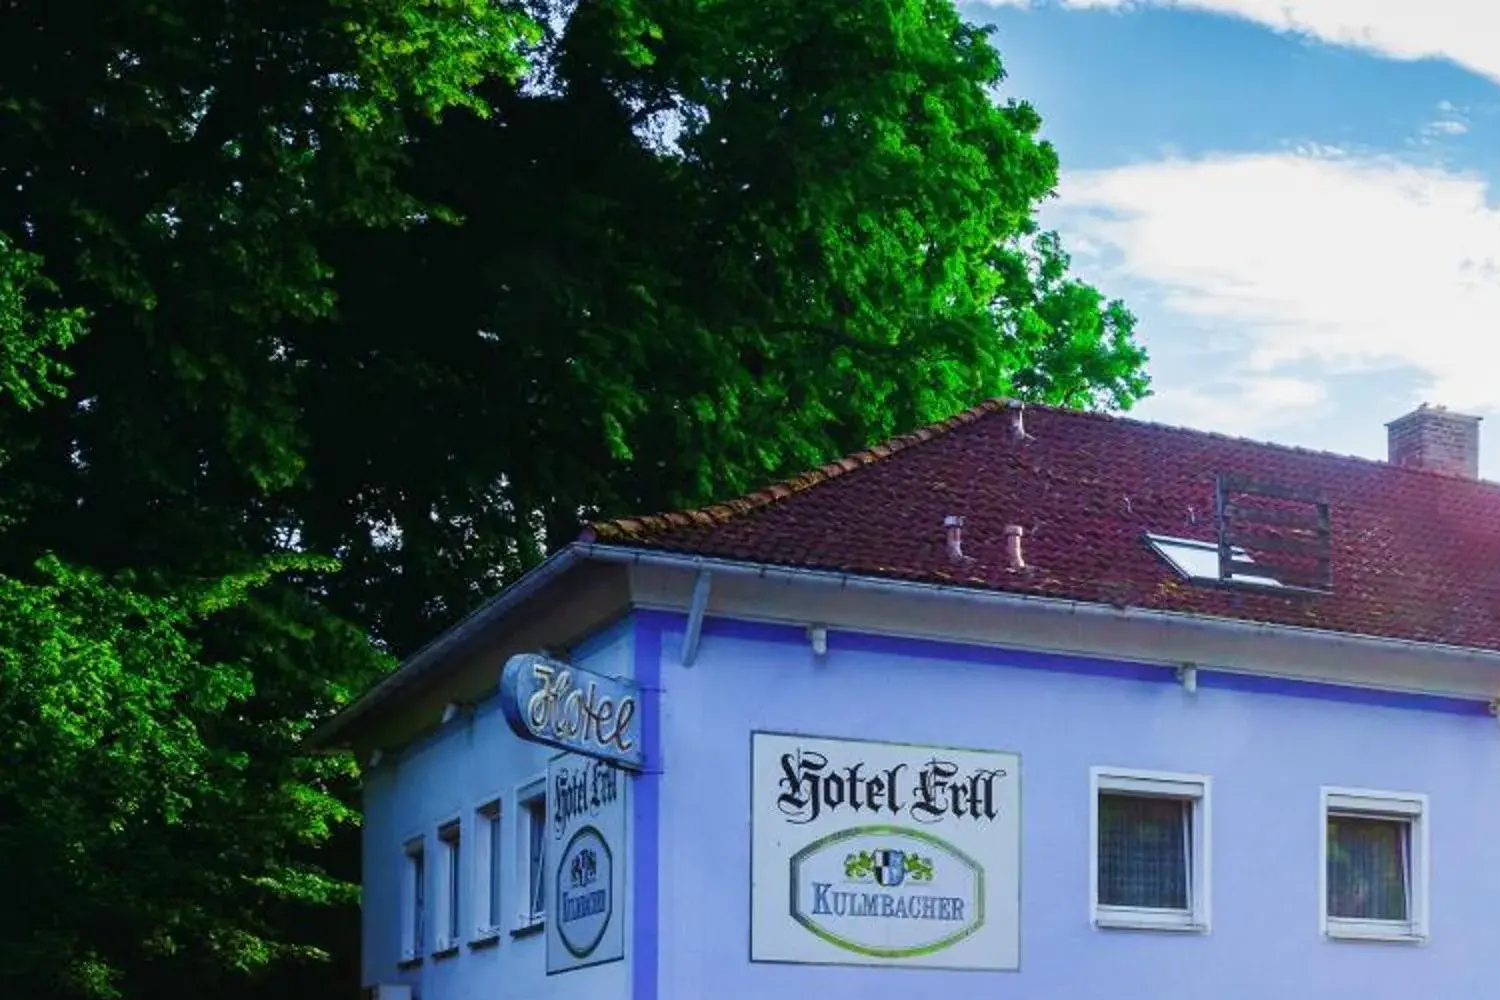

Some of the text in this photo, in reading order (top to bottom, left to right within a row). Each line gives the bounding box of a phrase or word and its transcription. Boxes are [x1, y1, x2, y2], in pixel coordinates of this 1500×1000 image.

[526, 663, 636, 752] Hotel
[777, 747, 1008, 825] Hotel Ertl
[811, 880, 966, 921] KULMBACHER
